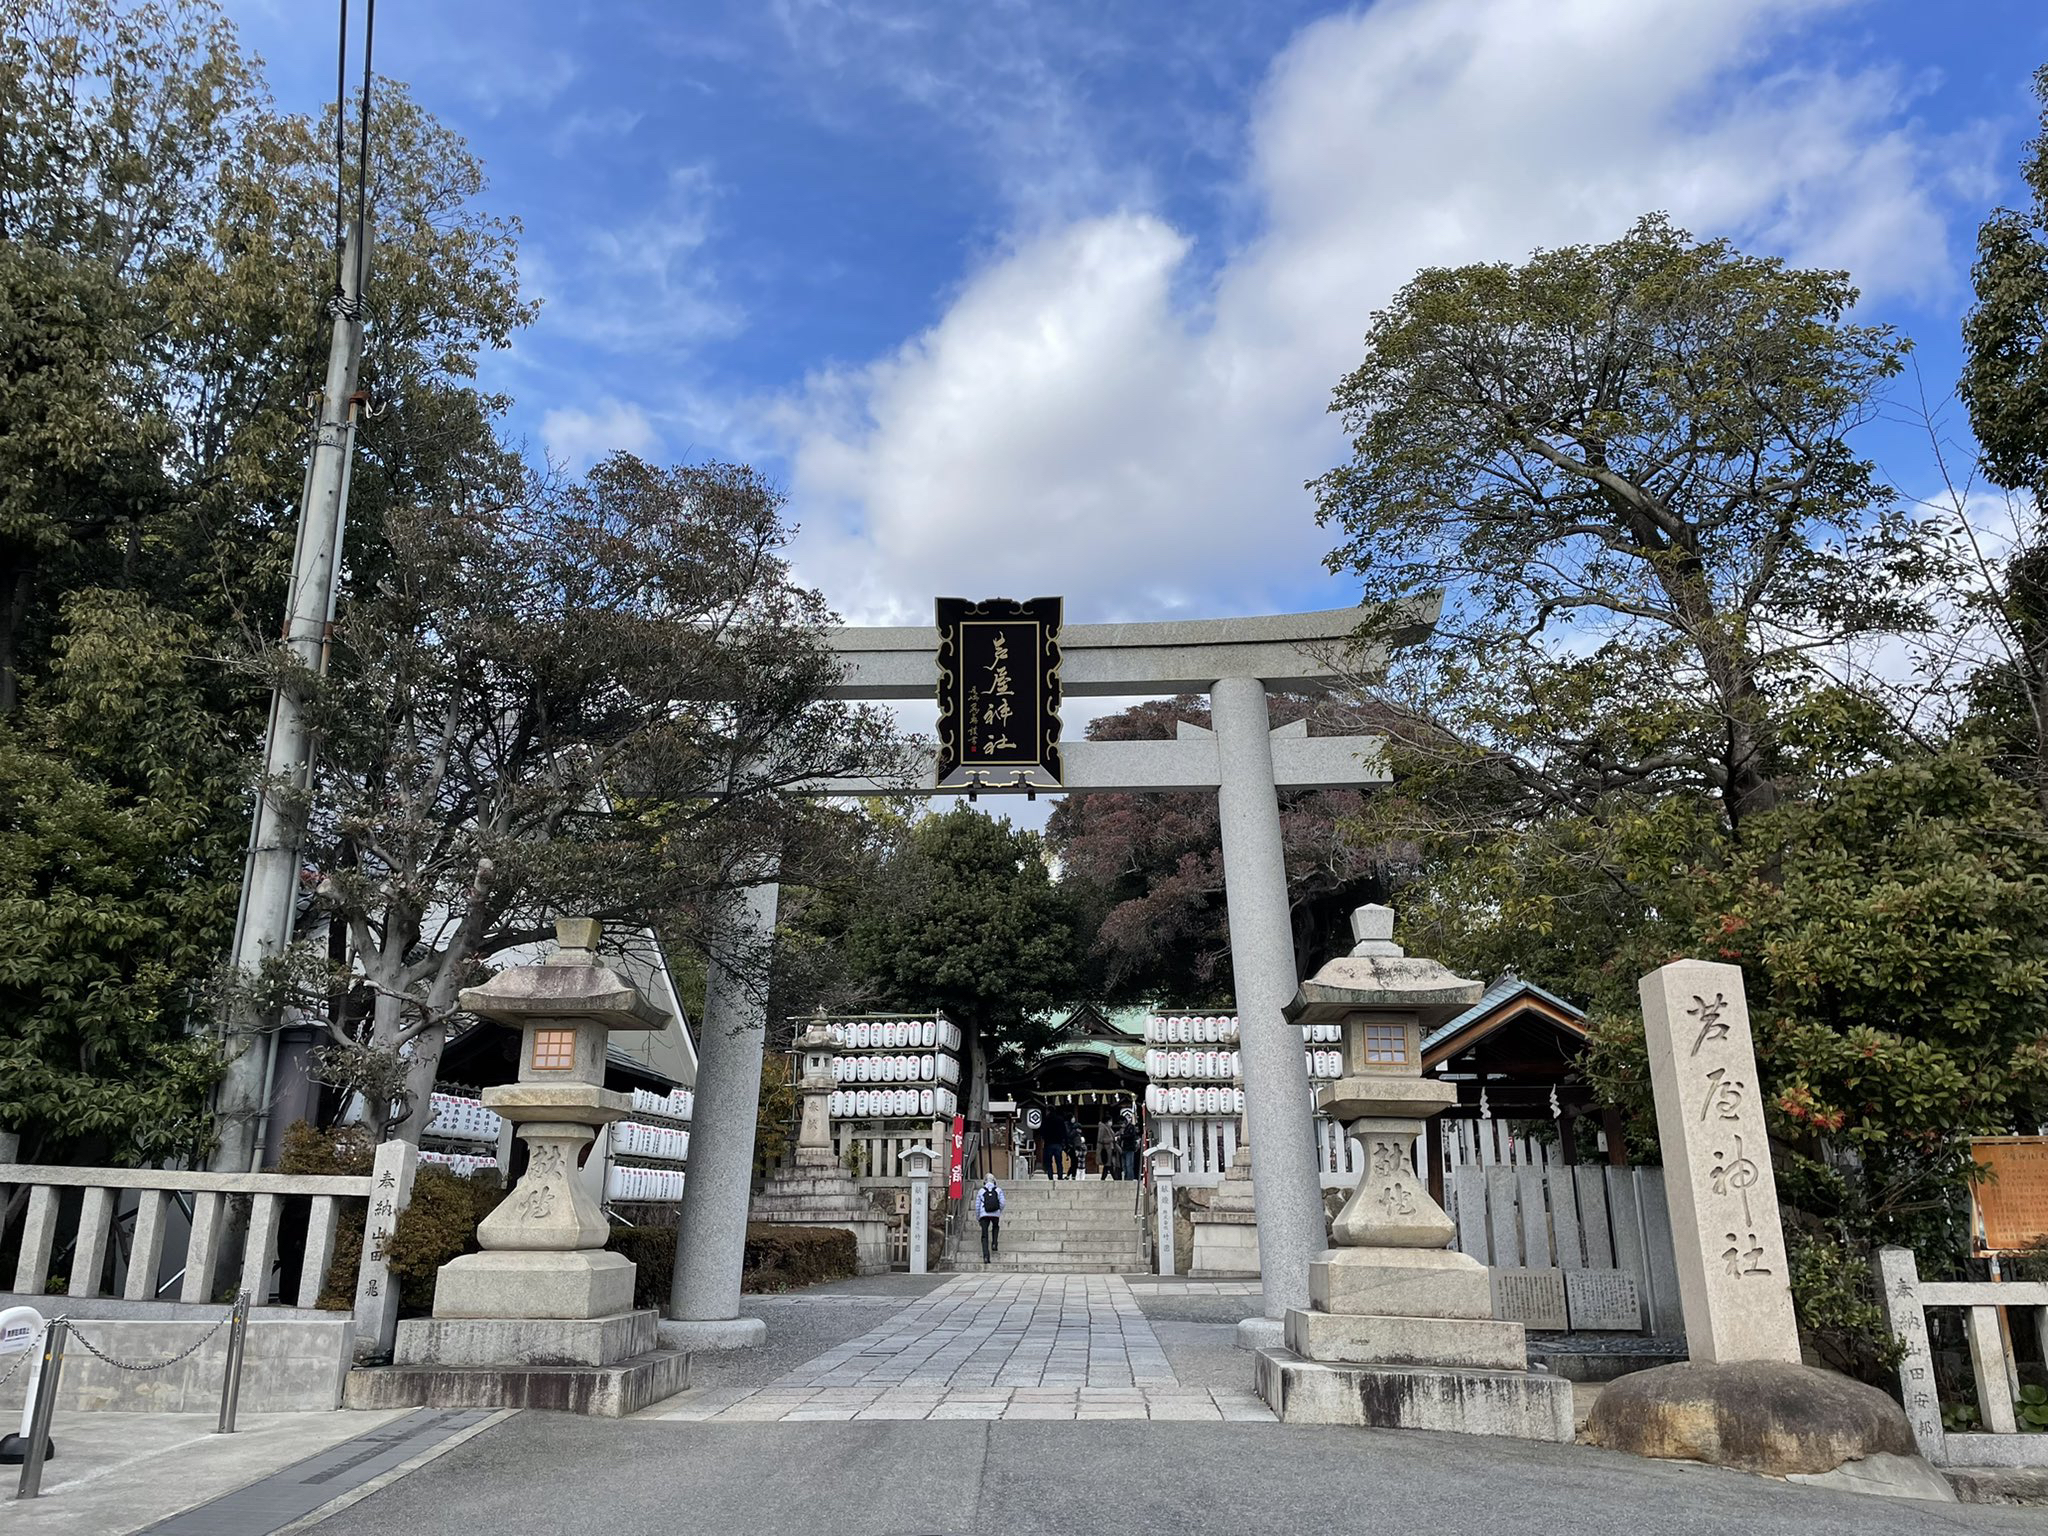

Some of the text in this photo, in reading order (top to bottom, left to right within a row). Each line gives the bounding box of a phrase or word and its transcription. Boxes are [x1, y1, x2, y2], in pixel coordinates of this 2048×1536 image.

[981, 630, 1017, 755] 芦屋神社
[1687, 992, 1772, 1280] 芦屋神社
[1894, 1277, 1934, 1437] 奉納山田安邦
